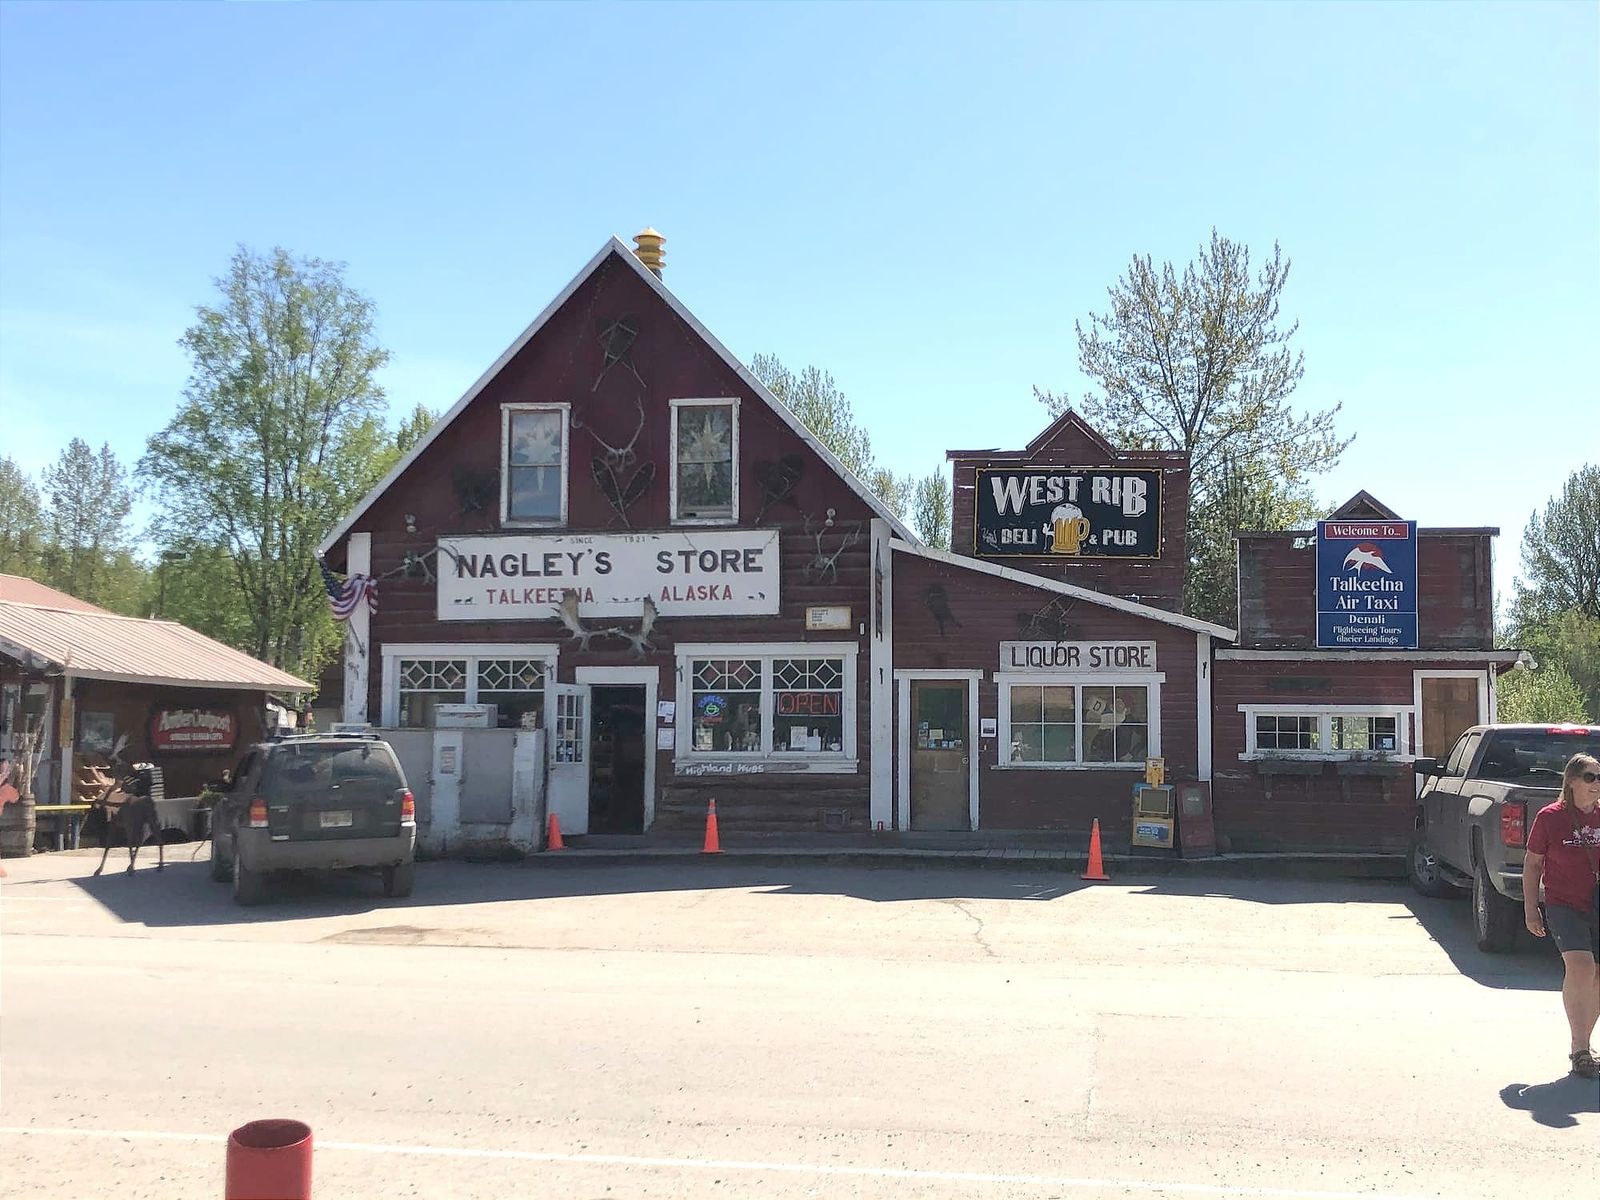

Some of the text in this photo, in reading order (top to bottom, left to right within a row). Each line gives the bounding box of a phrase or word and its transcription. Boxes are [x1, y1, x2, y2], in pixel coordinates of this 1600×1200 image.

[990, 475, 1148, 518] WEST RIB
[1001, 528, 1138, 546] DELI & PUB
[1332, 525, 1379, 536] Welcome
[457, 548, 764, 579] NAGLEY'S STORE
[1330, 576, 1404, 592] Talkeetna
[660, 584, 733, 602] ALASKA
[1335, 595, 1398, 610] Air Taxi
[1349, 614, 1385, 624] Denali
[1380, 626, 1402, 635] Tours
[1336, 635, 1399, 645] Glacier Landings
[1010, 645, 1152, 669] LIQUOR STORE
[779, 693, 839, 715] OPEN
[685, 763, 733, 776] Highland
